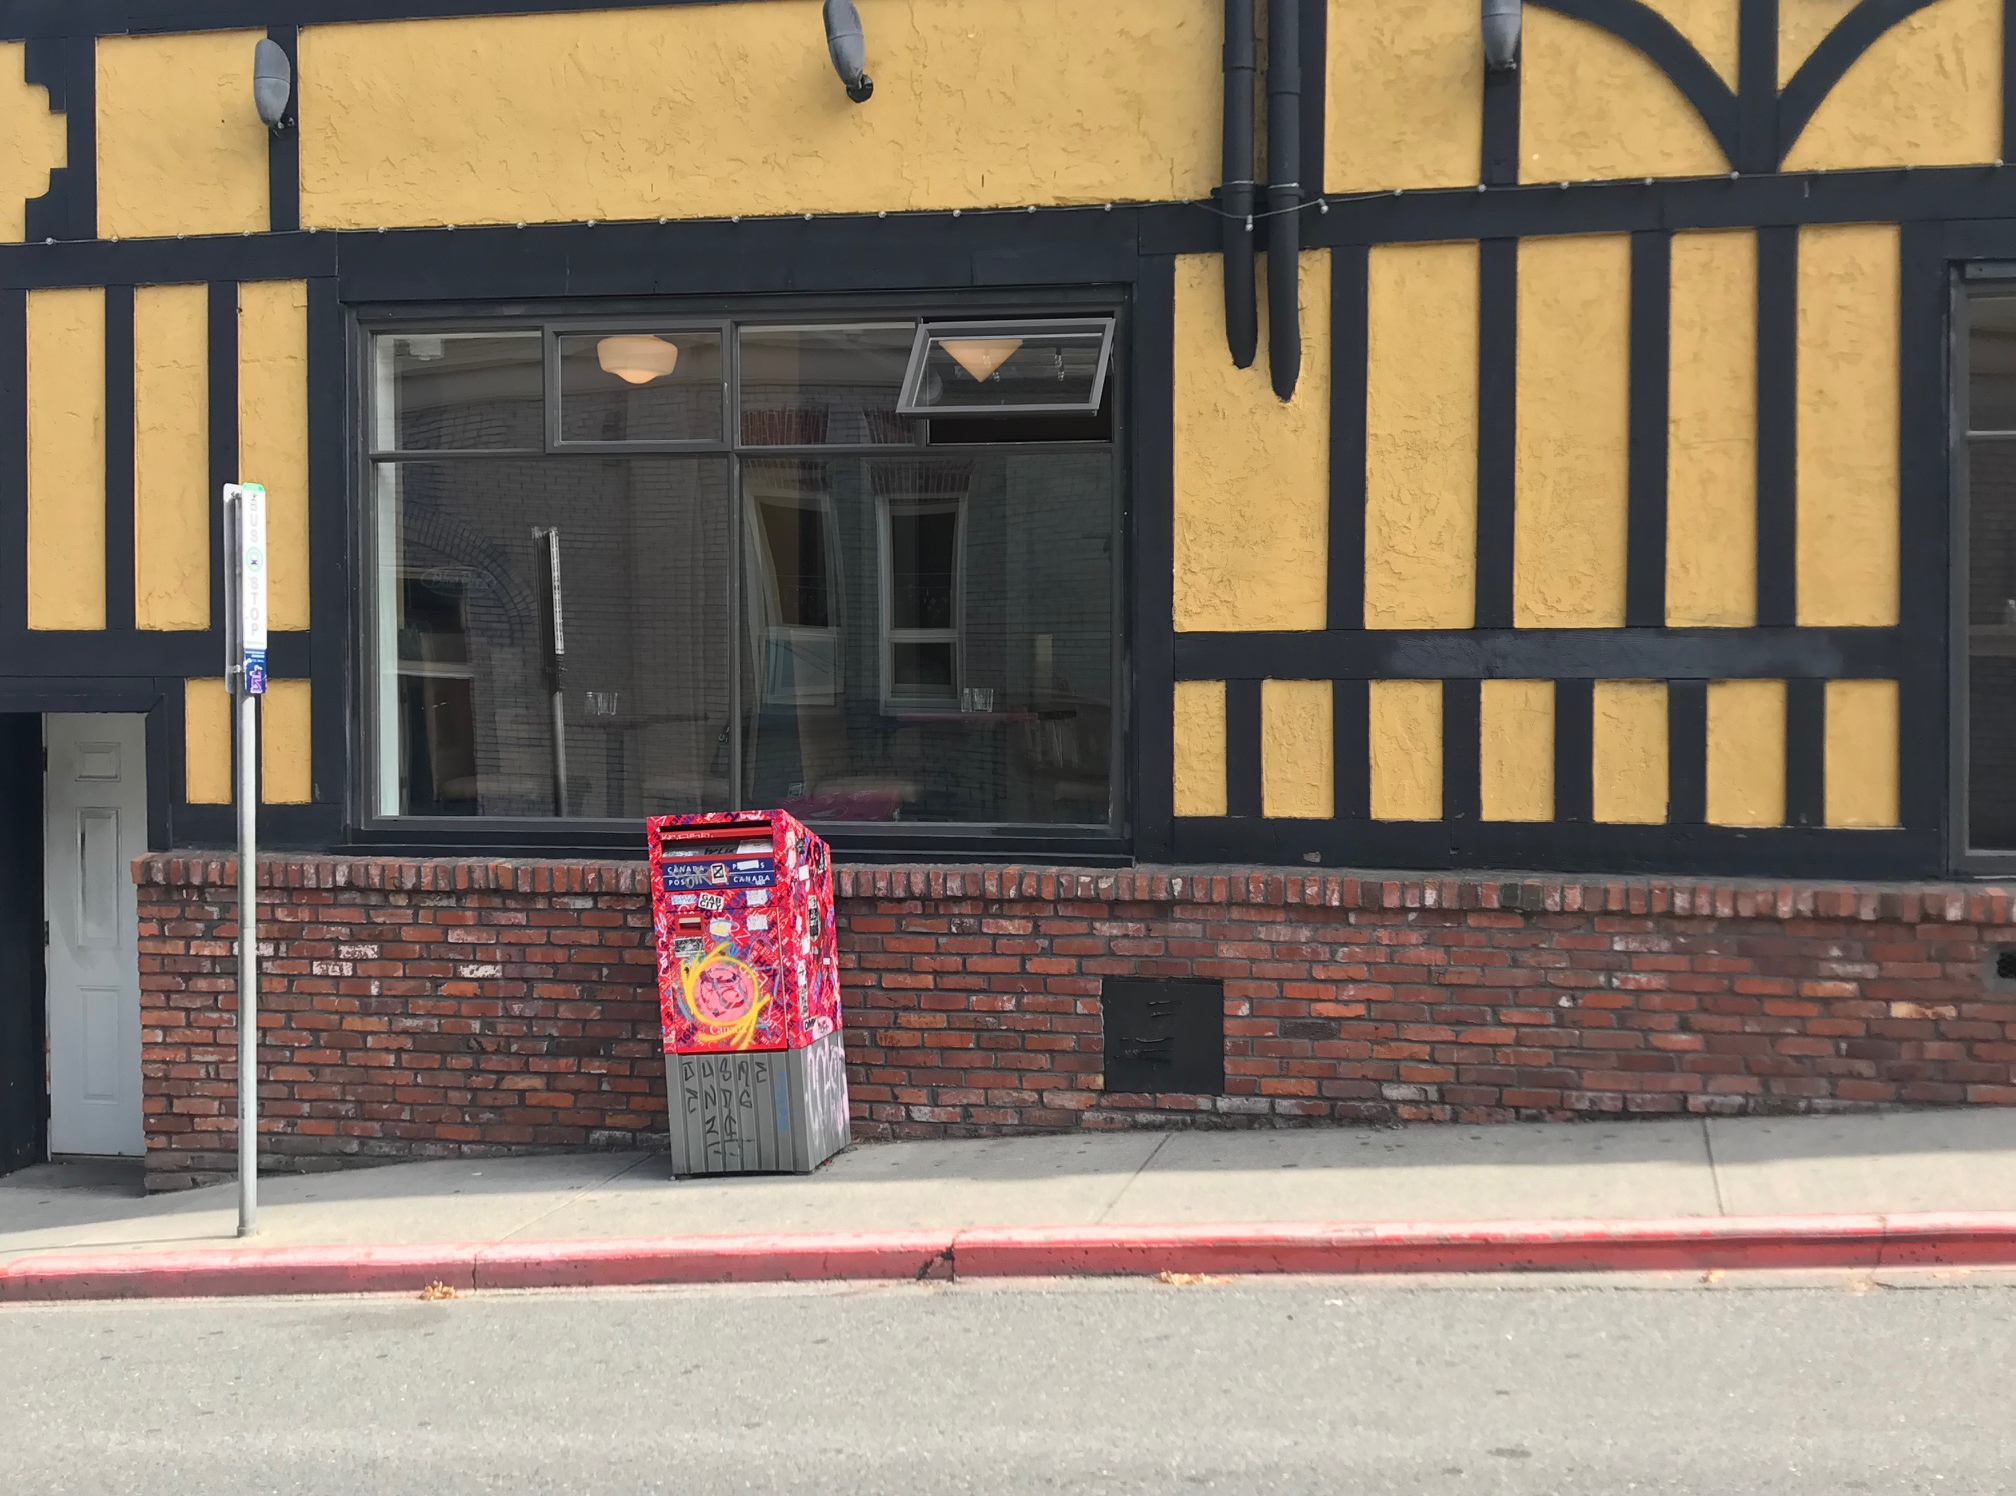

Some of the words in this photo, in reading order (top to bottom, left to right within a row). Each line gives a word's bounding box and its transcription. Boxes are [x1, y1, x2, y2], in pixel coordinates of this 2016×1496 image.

[250, 498, 259, 543] BUS
[250, 576, 259, 636] STOP
[667, 865, 705, 873] CANADA
[733, 874, 770, 883] CANADA
[700, 899, 721, 910] CITY
